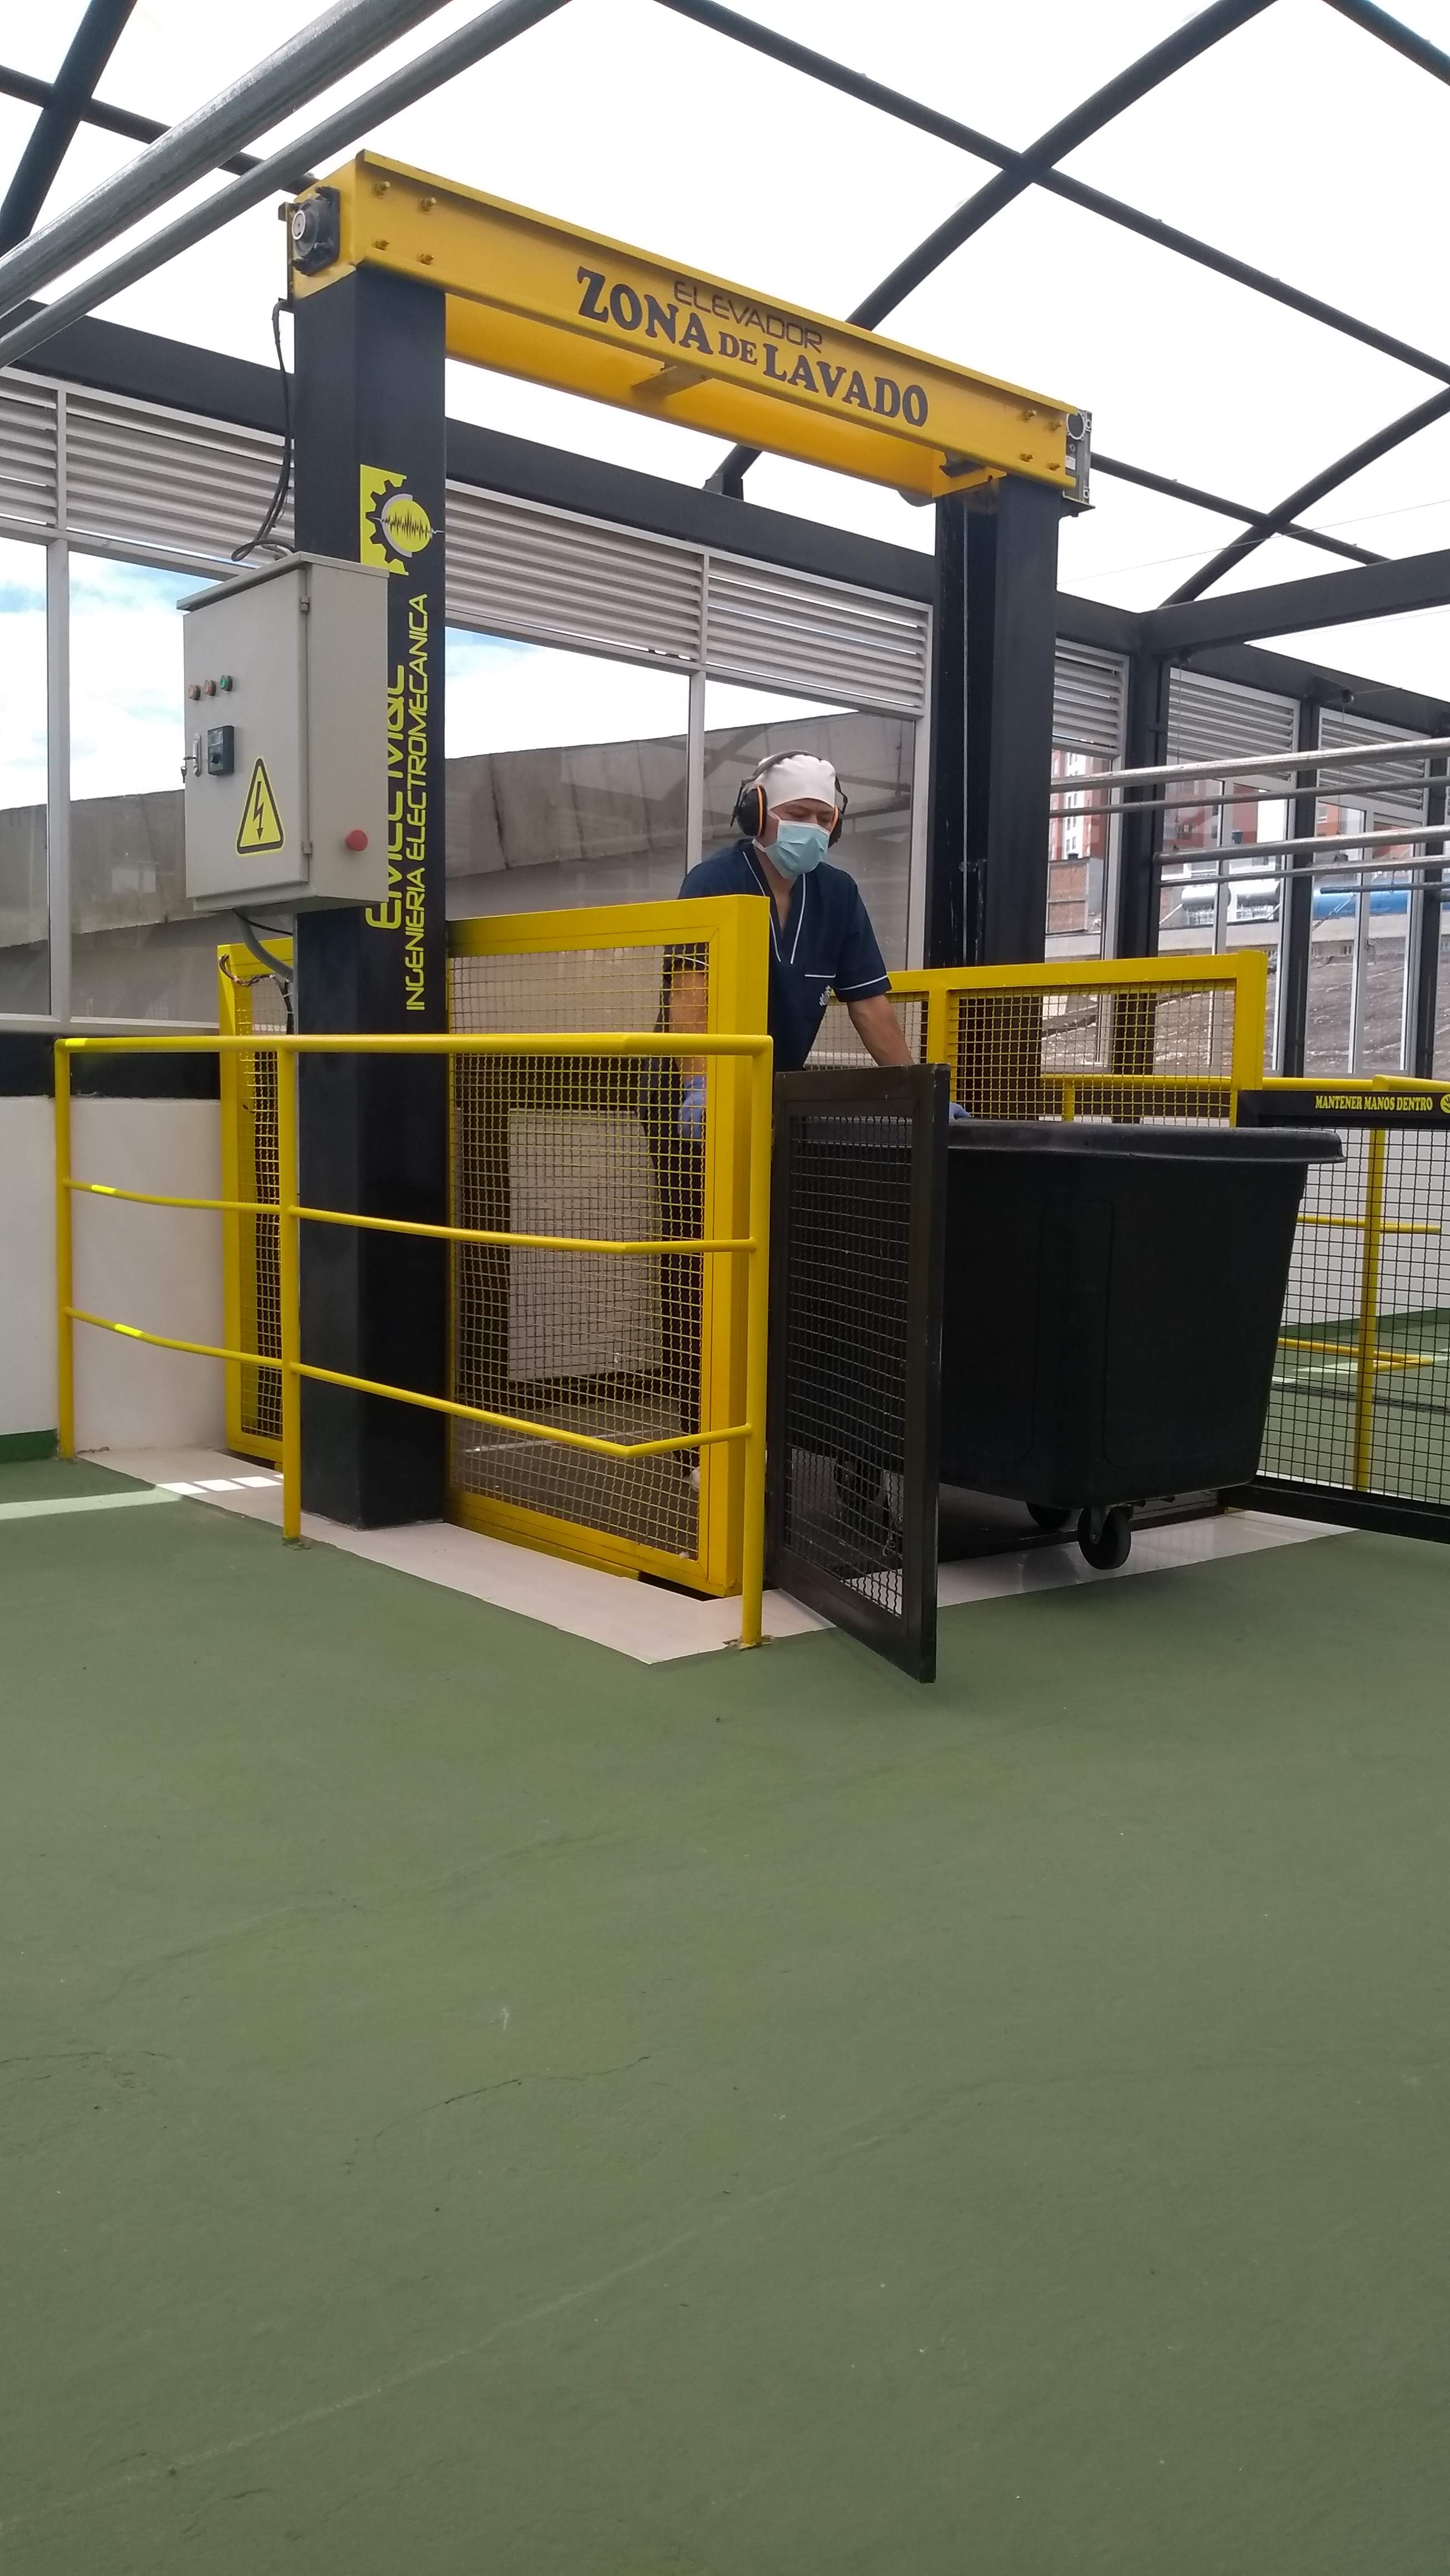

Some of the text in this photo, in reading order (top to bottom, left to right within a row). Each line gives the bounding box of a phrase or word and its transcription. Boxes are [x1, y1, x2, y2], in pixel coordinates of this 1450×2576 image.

[577, 266, 928, 428] ZONA DE LAVADO
[673, 280, 823, 354] ELEVADOR
[405, 594, 428, 1010] INGENIERIA ELECTROMECANICA
[1315, 1095, 1433, 1111] MANTENER MANOS DENTRO
